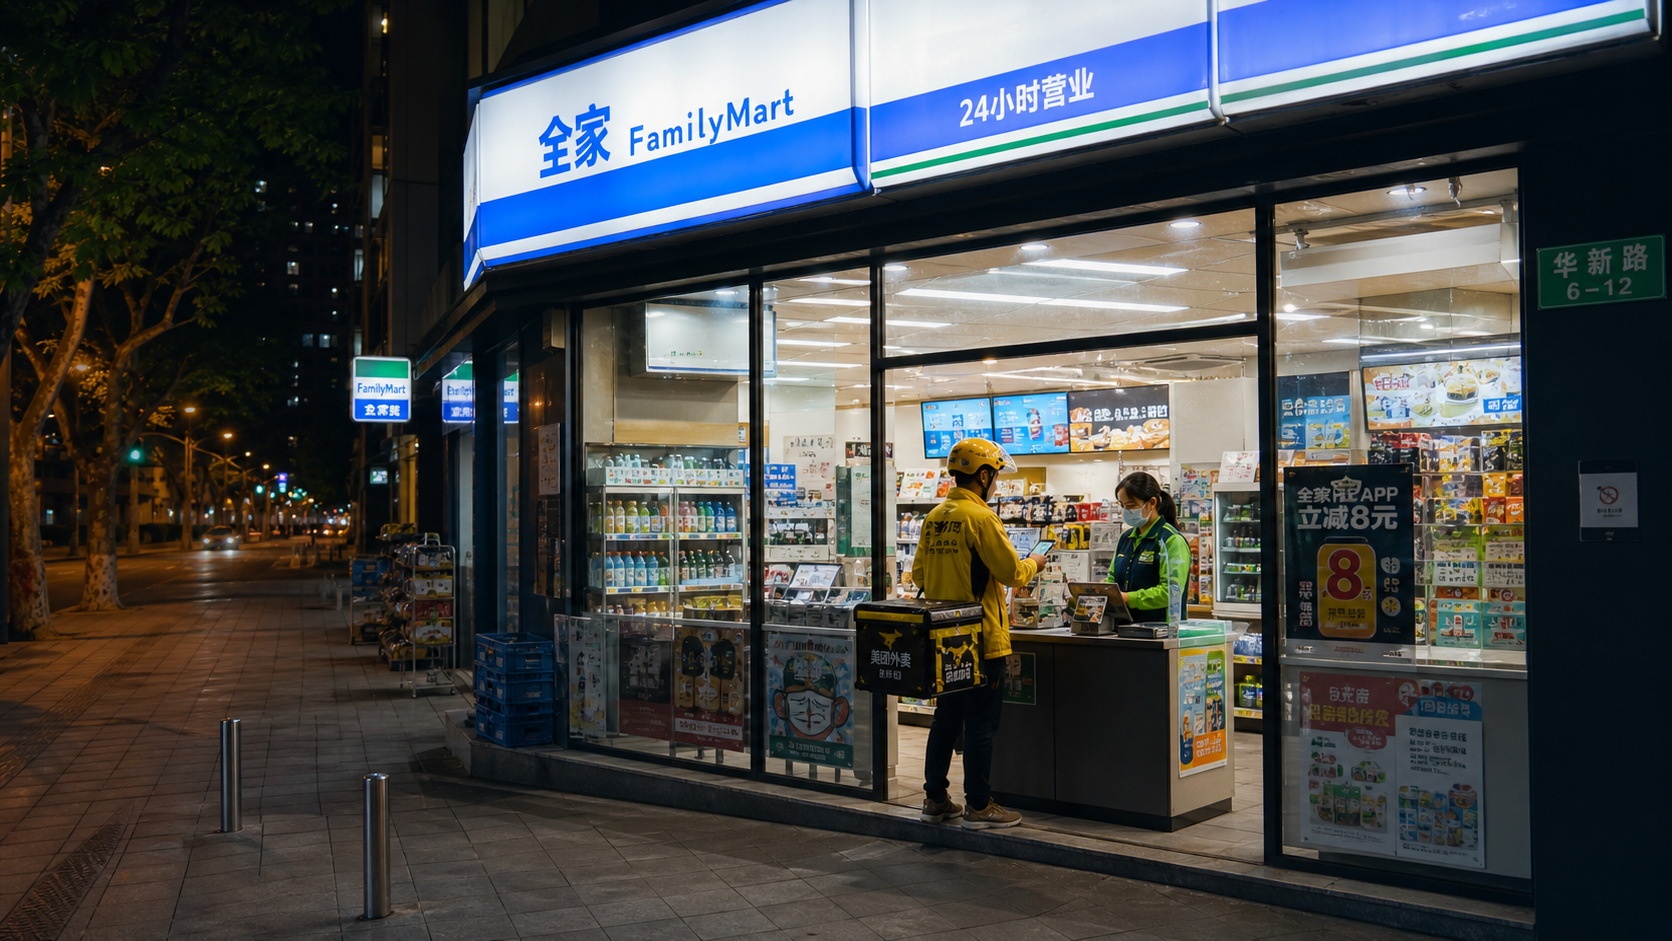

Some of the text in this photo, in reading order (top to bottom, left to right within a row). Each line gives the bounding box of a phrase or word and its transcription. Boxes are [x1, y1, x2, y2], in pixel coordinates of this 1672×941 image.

[959, 67, 1095, 127] 24小时营业
[539, 89, 795, 179] 全家 FamilyMart
[1553, 243, 1649, 279] 华新路
[1566, 277, 1633, 301] 6-12
[357, 383, 406, 396] FamilyMart
[1297, 504, 1399, 530] 立减8元
[1326, 549, 1363, 600] 8
